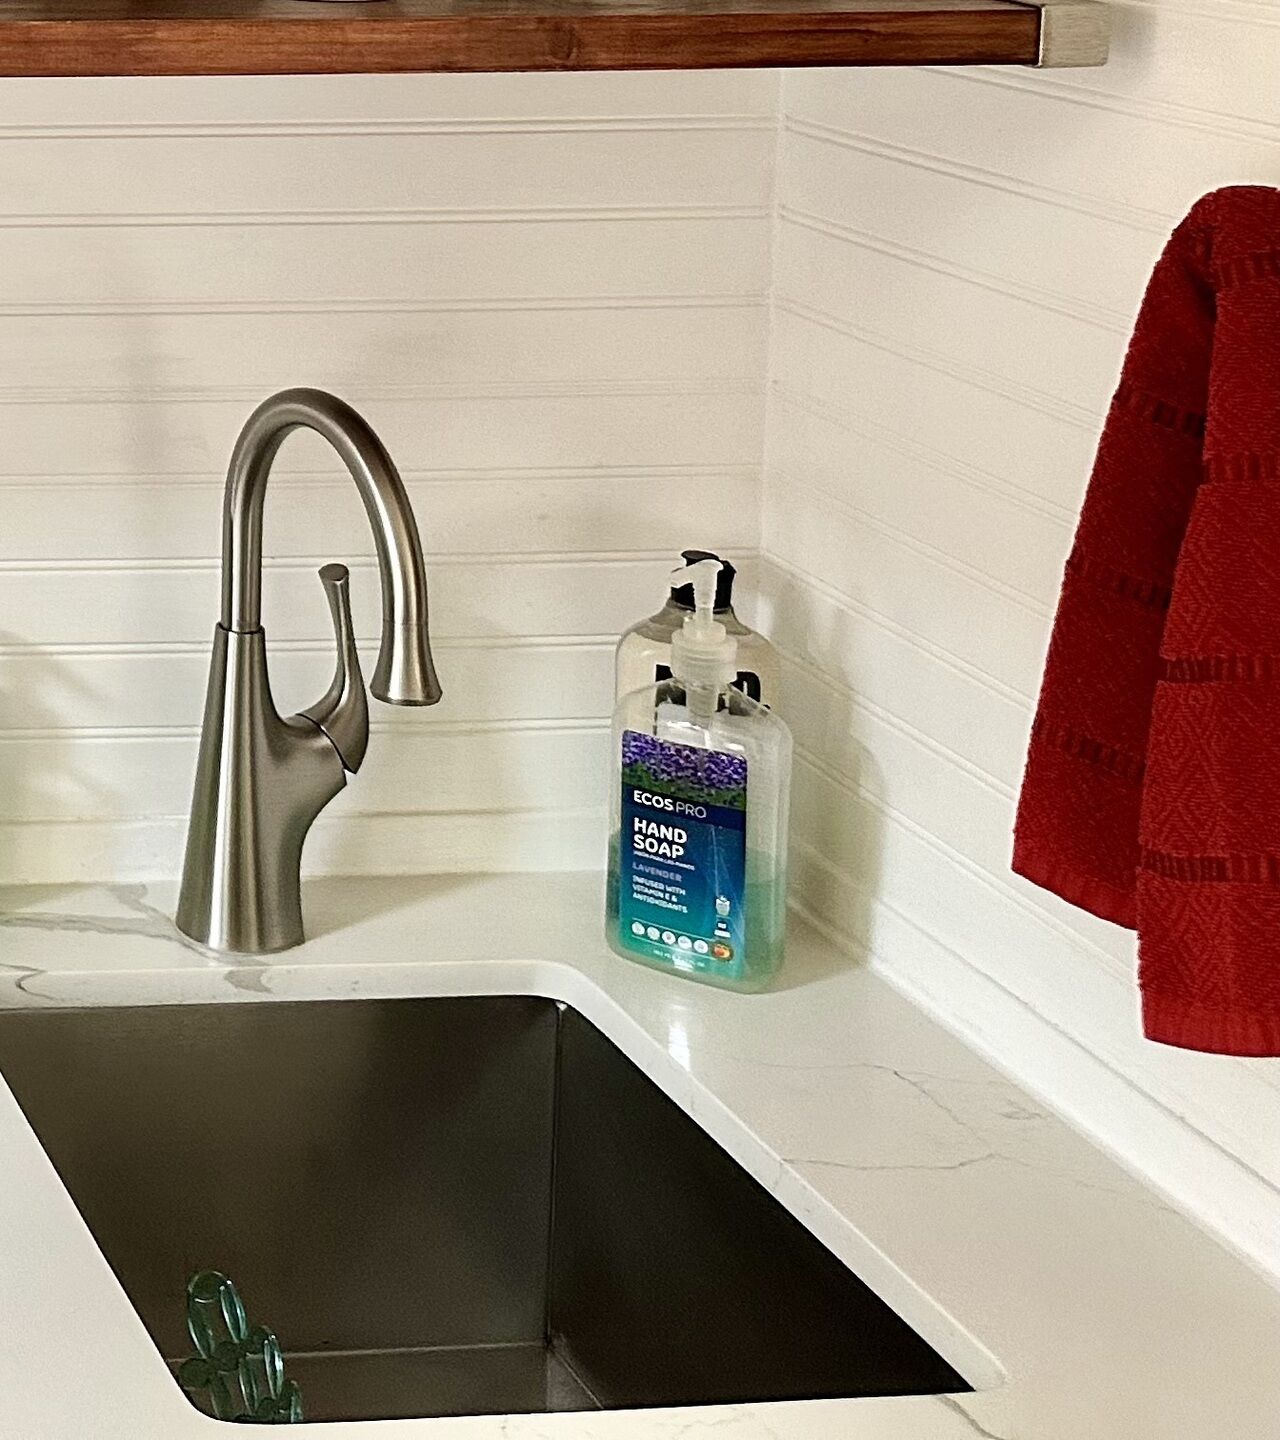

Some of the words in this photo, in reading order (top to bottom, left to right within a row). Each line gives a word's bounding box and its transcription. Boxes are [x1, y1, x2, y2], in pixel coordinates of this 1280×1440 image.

[633, 789, 674, 813] ECOS
[676, 801, 707, 819] PRO
[633, 817, 688, 844] HAND
[633, 834, 685, 859] SOAP
[632, 861, 682, 883] LAVENDER
